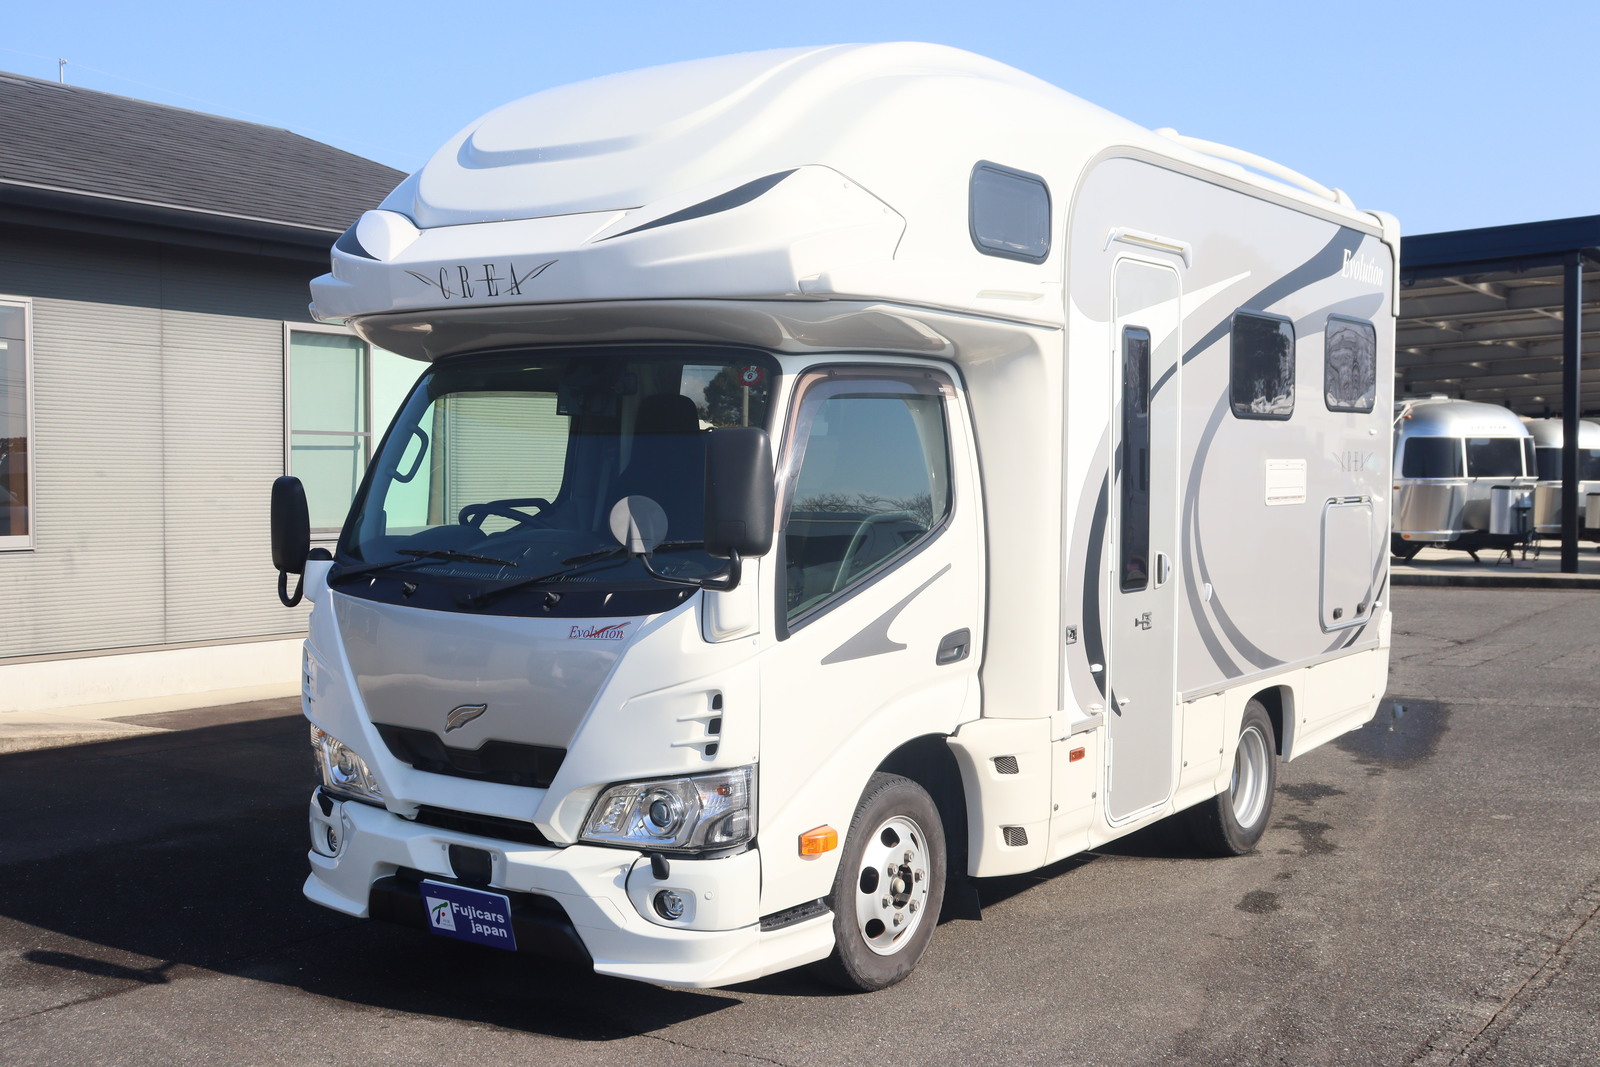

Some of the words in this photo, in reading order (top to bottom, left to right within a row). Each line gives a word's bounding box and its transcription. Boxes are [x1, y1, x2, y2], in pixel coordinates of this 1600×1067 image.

[1341, 248, 1384, 287] Evolution
[439, 262, 522, 300] CREA
[568, 625, 624, 639] Evolution
[451, 902, 505, 924] Fujicars
[470, 919, 508, 938] japan
